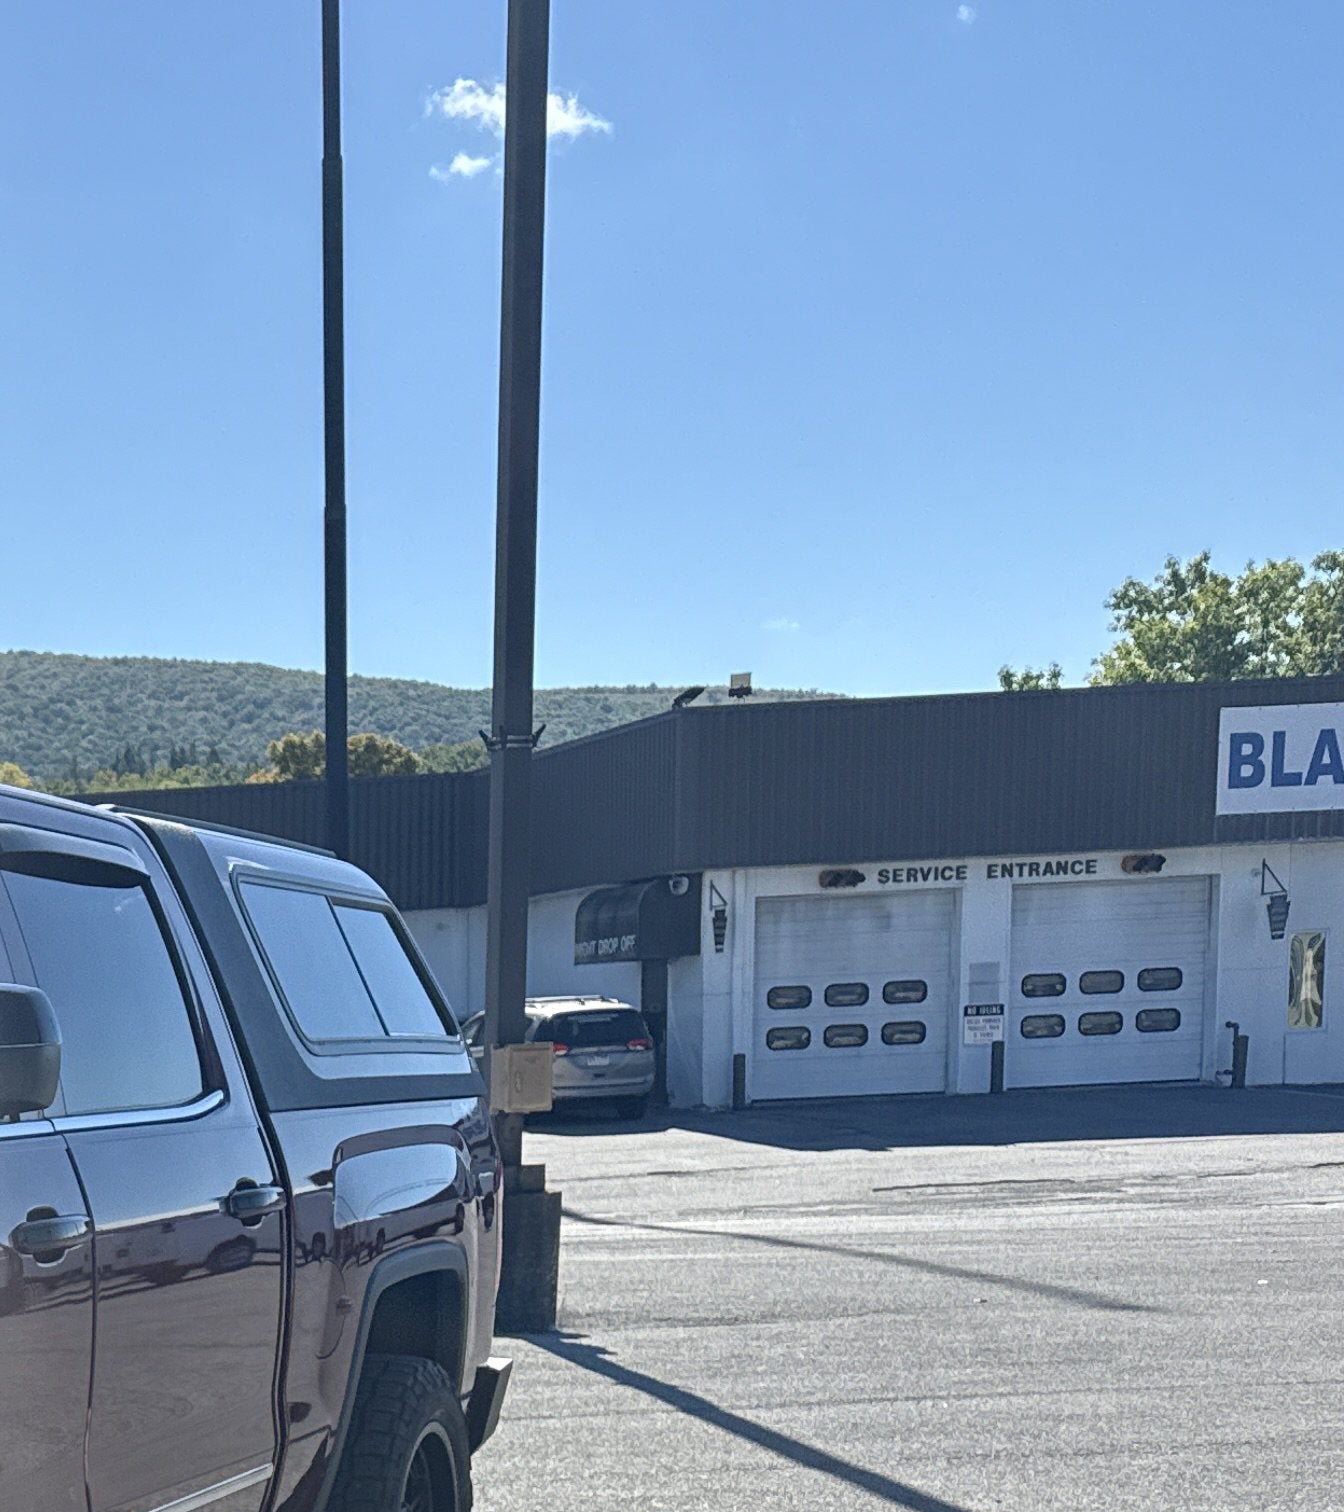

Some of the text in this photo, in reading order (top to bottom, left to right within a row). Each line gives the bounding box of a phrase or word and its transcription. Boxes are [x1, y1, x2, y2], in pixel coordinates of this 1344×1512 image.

[1228, 729, 1344, 789] BLA
[878, 859, 1098, 885] SERVICE ENTRANCE
[598, 937, 618, 955] DROP
[620, 934, 637, 952] OFF
